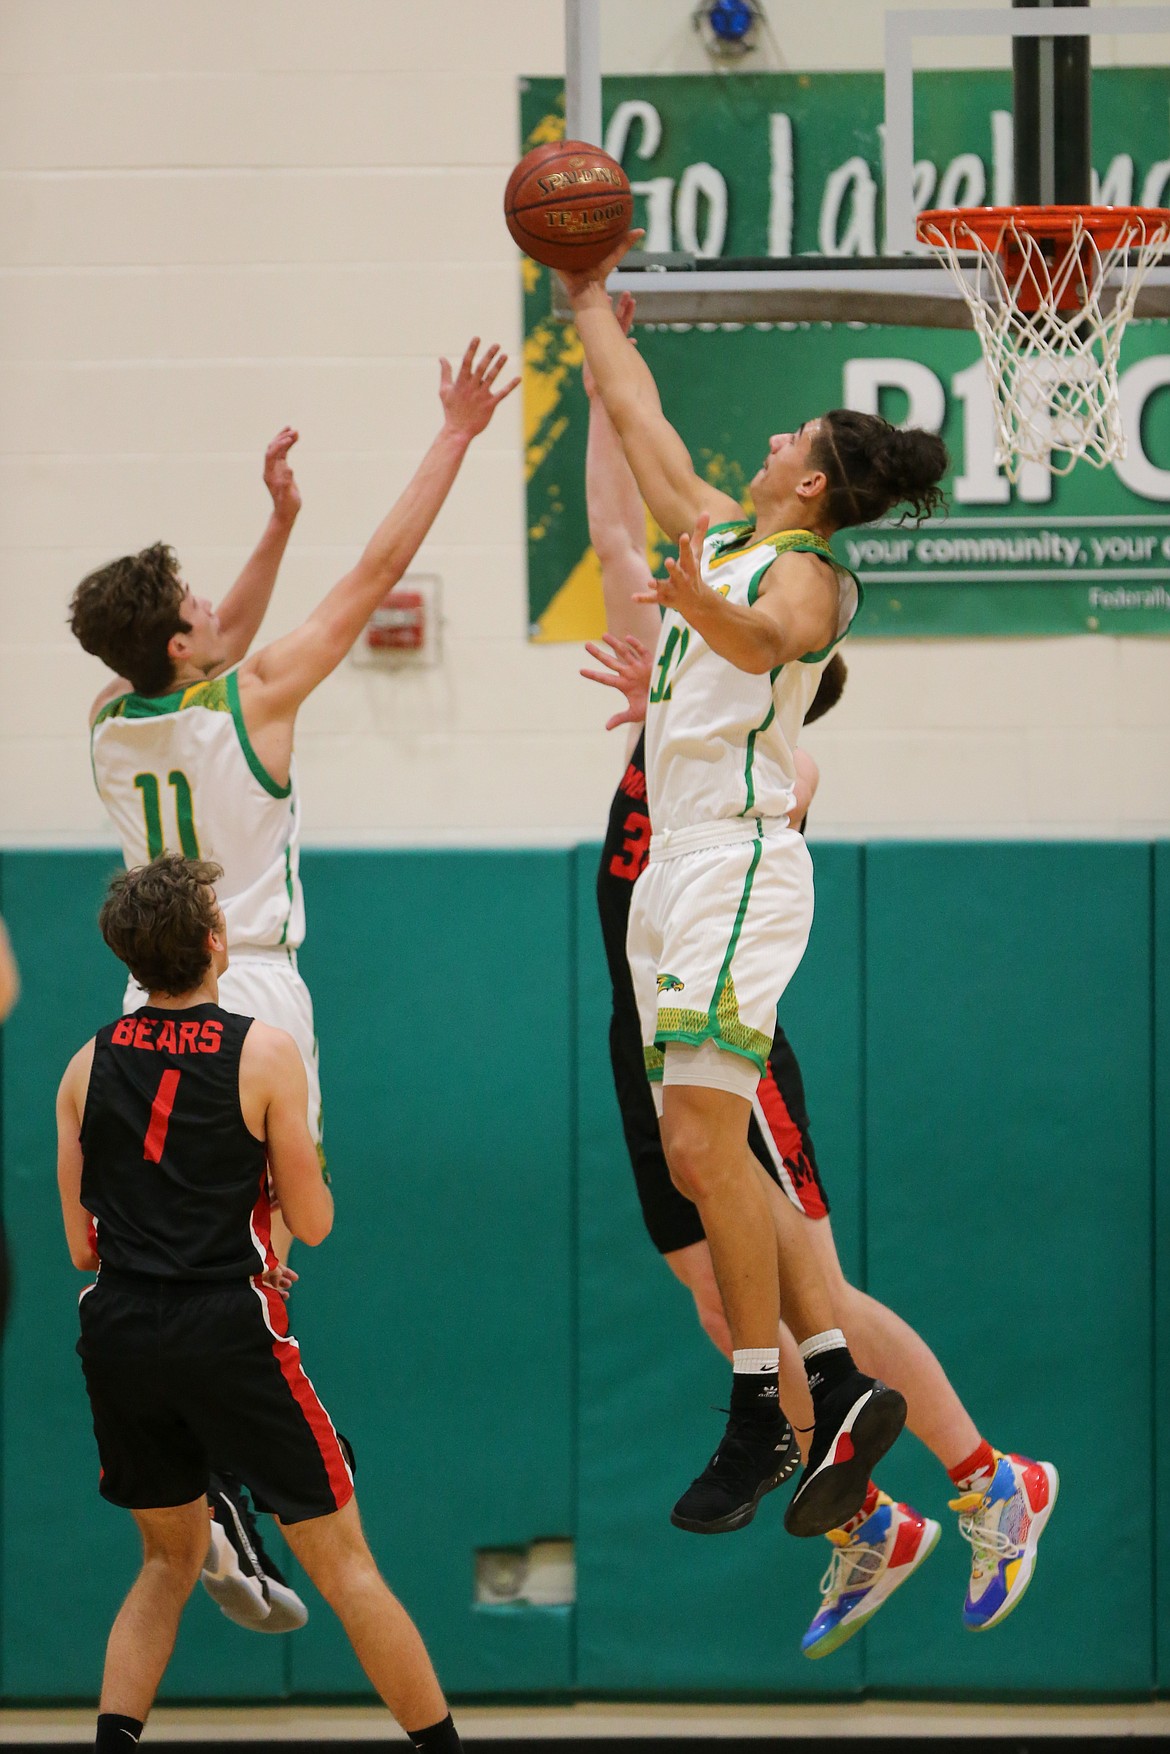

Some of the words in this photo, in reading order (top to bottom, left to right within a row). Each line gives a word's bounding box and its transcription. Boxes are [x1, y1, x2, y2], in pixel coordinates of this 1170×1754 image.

[537, 167, 622, 197] SPALDING
[606, 100, 728, 258] Go
[544, 201, 625, 227] TF-1000
[846, 539, 912, 569] your
[916, 530, 1087, 567] community,
[1090, 536, 1157, 566] your
[133, 769, 200, 862] 11
[609, 811, 653, 880] 3
[111, 1016, 224, 1055] BEARS
[143, 1069, 181, 1165] 1
